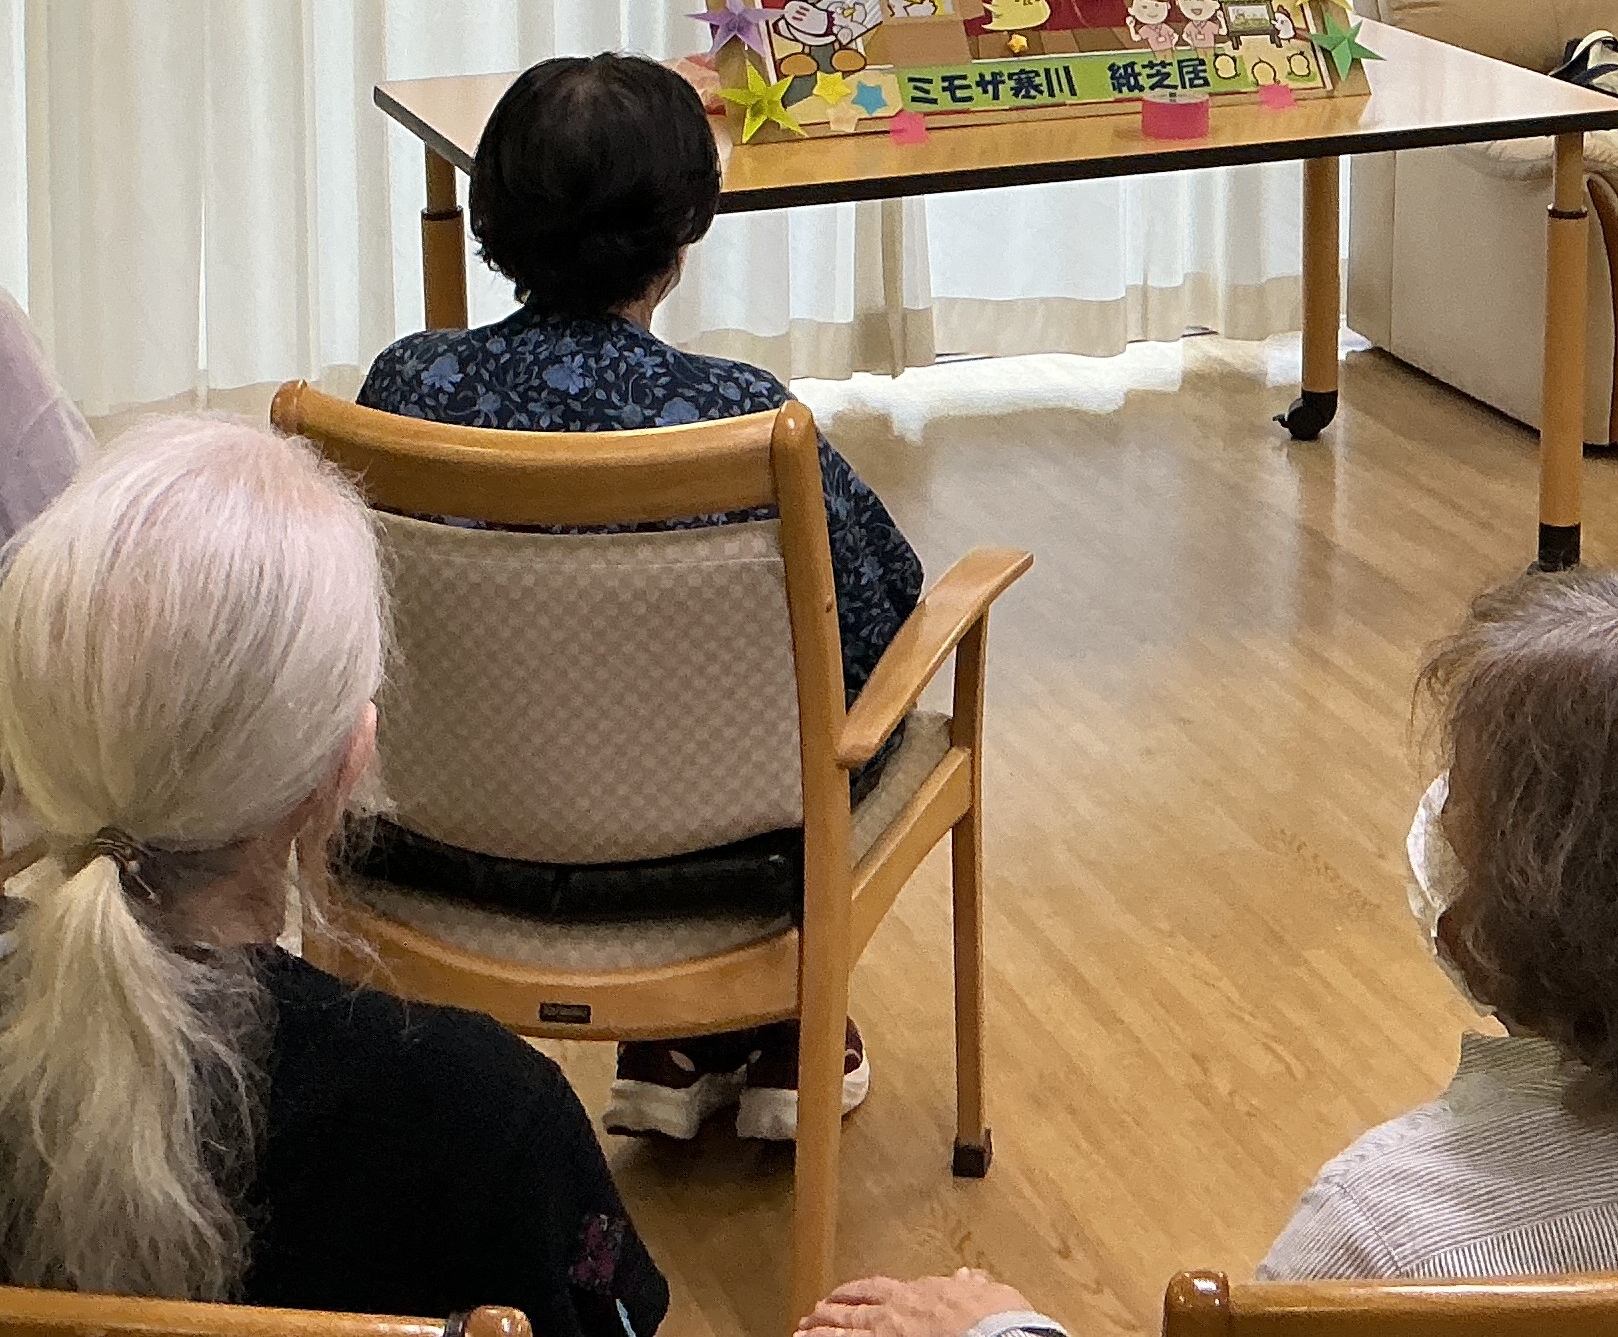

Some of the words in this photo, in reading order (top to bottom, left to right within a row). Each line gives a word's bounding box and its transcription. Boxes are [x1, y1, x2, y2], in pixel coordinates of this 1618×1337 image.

[906, 65, 1079, 105] ミモザ寒川
[1107, 57, 1213, 94] 紙芝居
